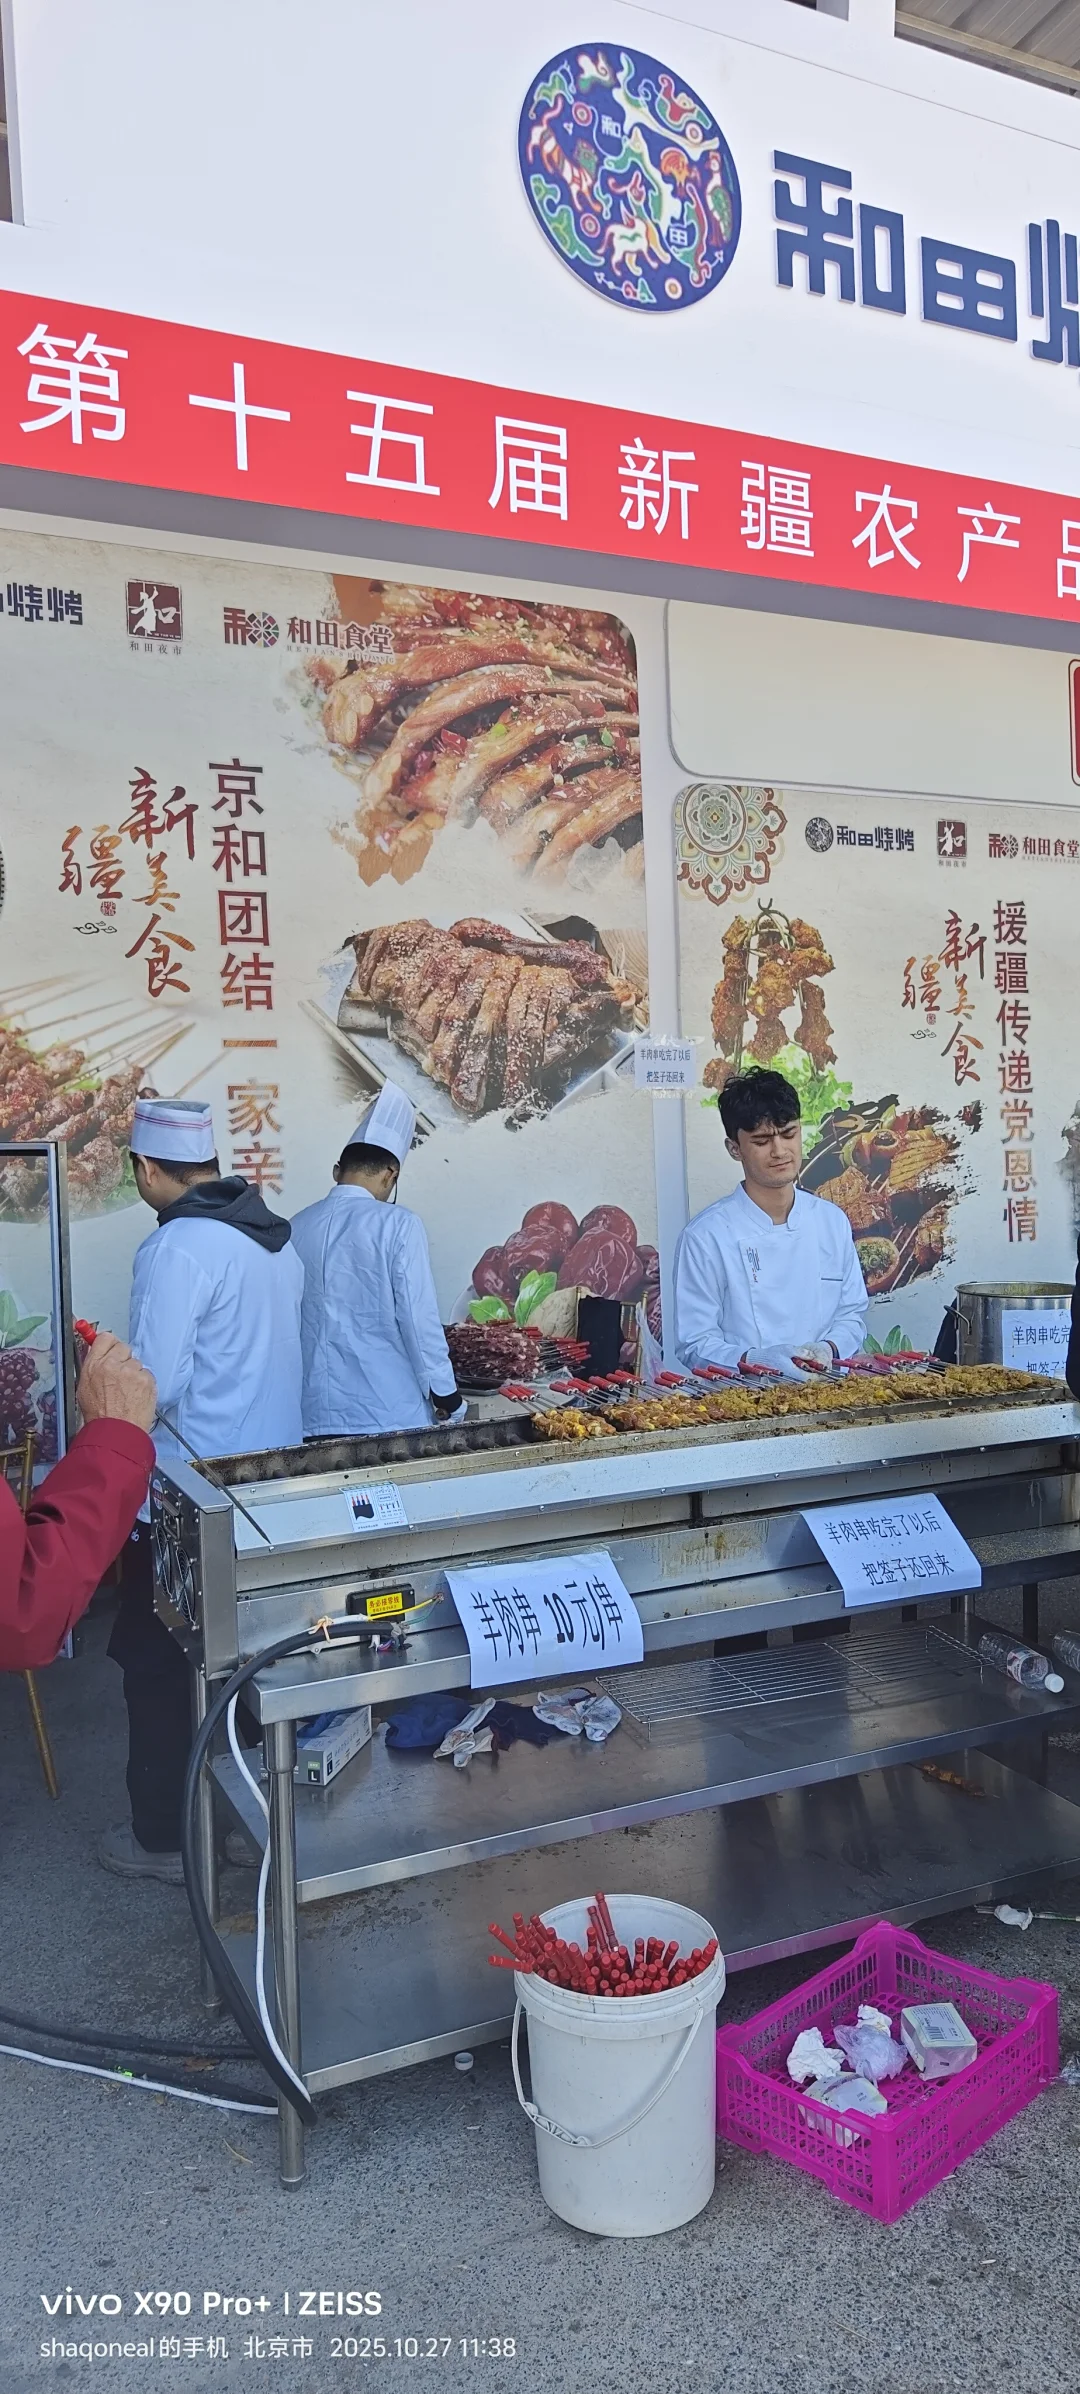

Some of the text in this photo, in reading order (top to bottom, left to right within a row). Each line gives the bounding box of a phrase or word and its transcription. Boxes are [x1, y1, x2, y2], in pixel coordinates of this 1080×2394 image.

[0, 582, 83, 625] 烧烤
[129, 641, 182, 655] 和田夜市
[286, 616, 395, 655] 和田食堂
[836, 825, 915, 852] 和田烧烤
[1023, 836, 1080, 859] 和田食堂
[208, 757, 285, 1196] 京和团结一家亲
[640, 1048, 691, 1061] 羊肉串吃完了以后
[646, 1070, 685, 1083] 把签子还回来
[992, 899, 1039, 1244] 援疆传递党恩情
[824, 1510, 942, 1545] 羊肉串吃完了以后
[862, 1552, 955, 1586] 把签子还回来
[311, 1771, 318, 1781] L
